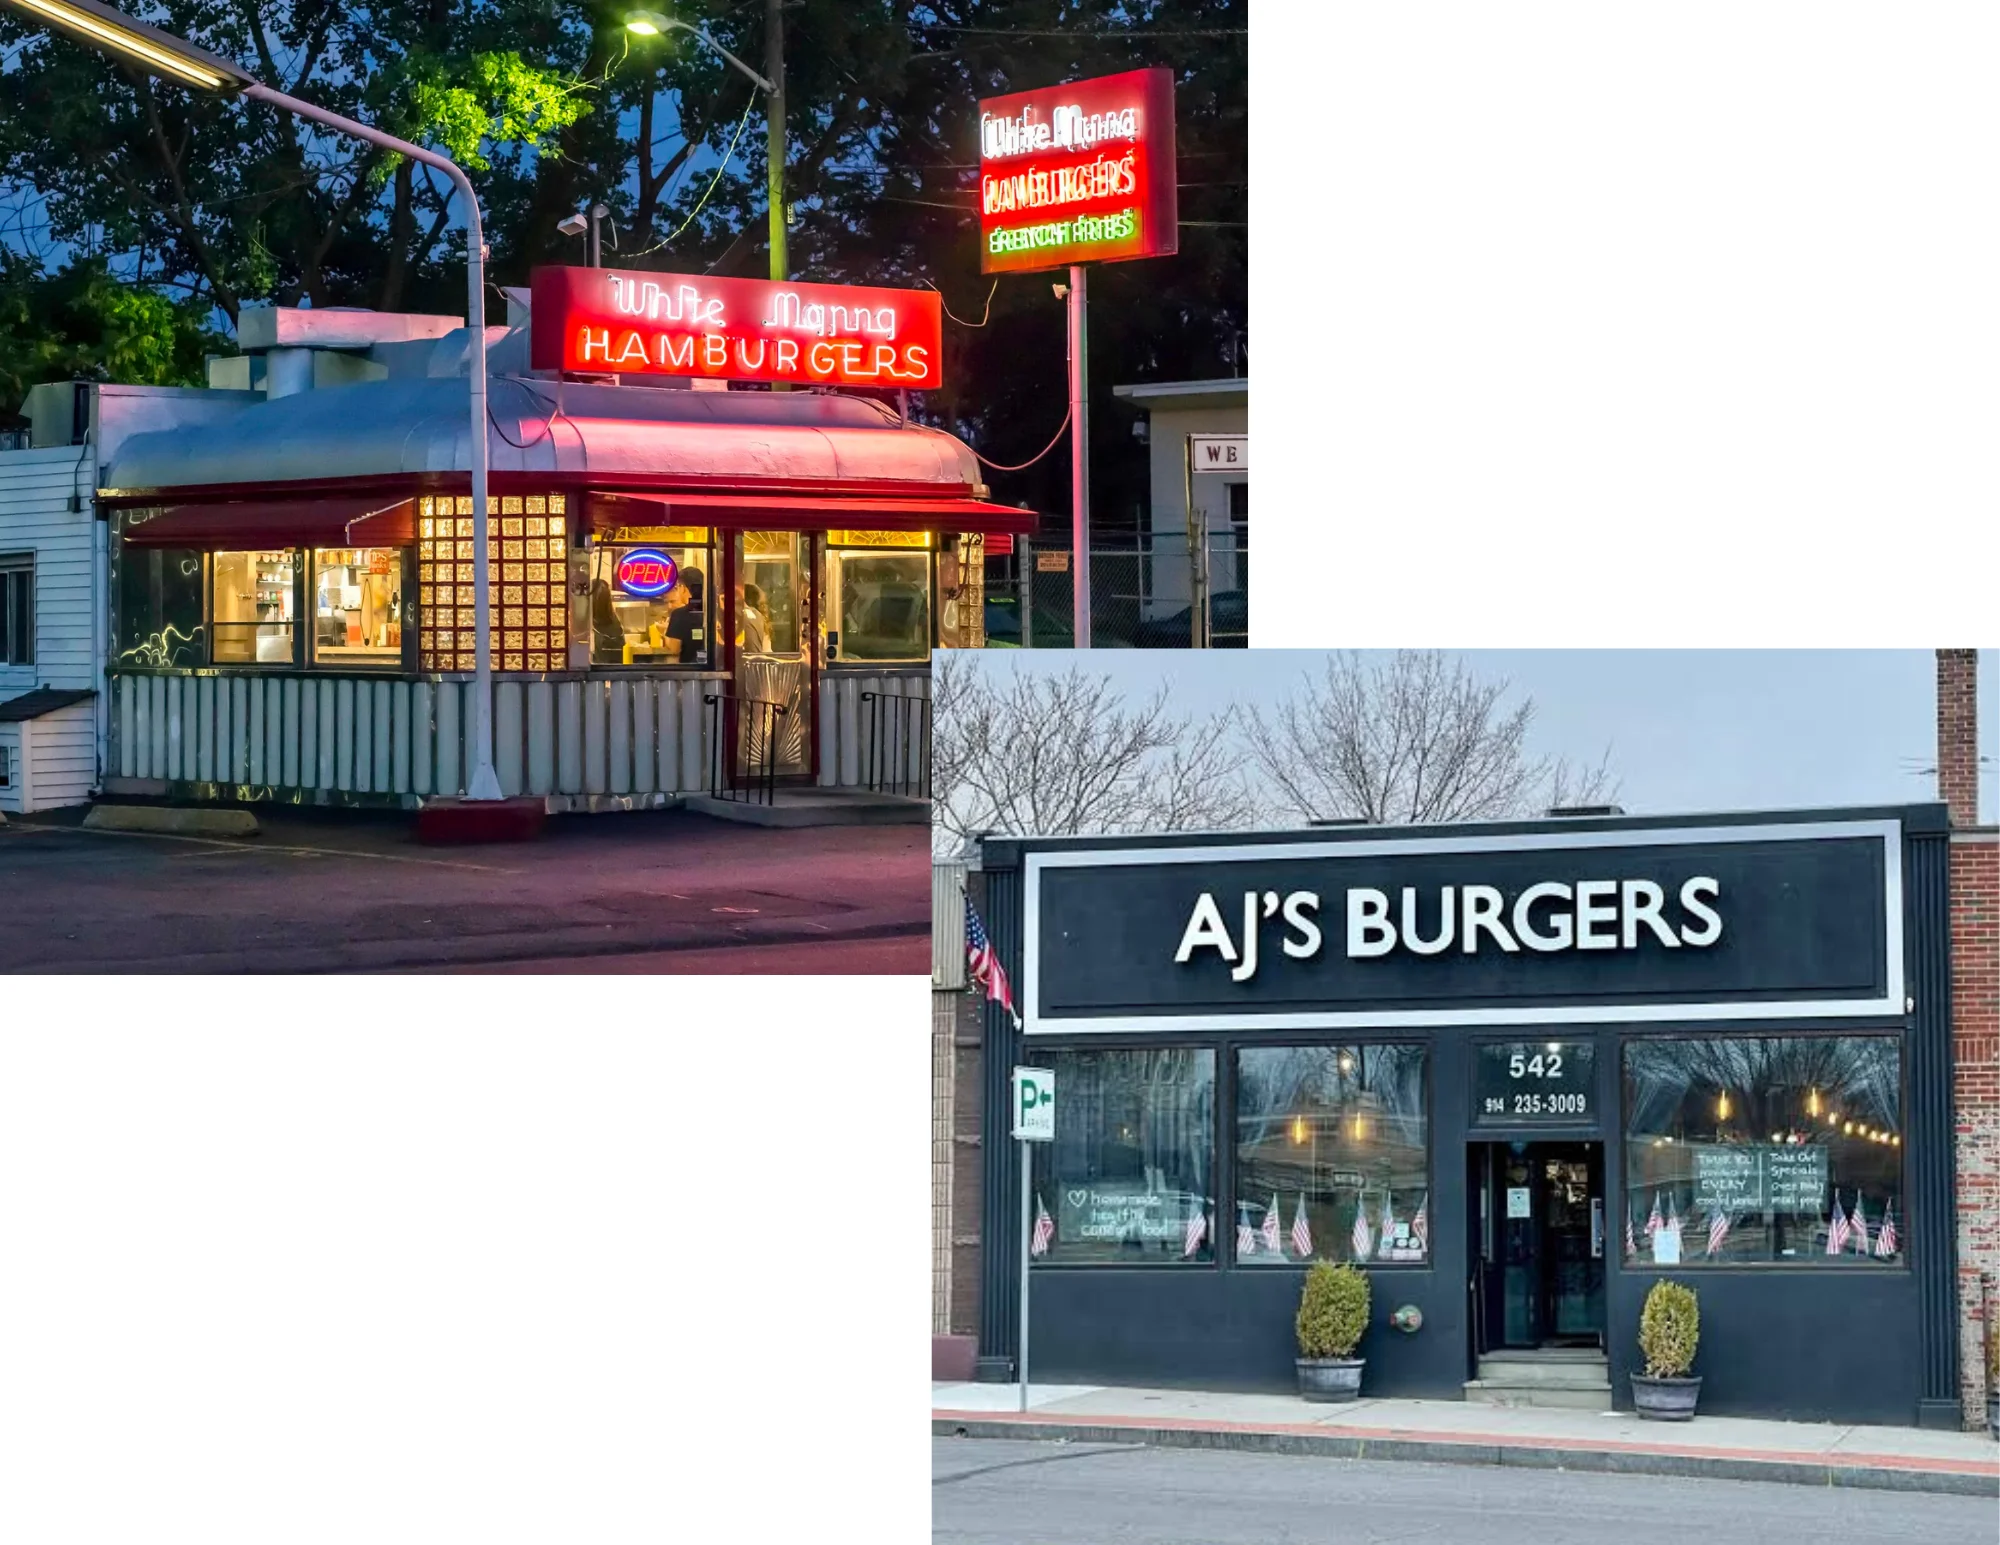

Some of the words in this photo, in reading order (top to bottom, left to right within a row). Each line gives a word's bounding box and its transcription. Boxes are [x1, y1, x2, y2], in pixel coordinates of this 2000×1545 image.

[982, 148, 1137, 215] HAMBURGERS
[989, 220, 1071, 253] FRENCH
[1072, 208, 1136, 243] FRIES
[607, 273, 726, 327] White
[761, 291, 896, 340] Manna
[582, 326, 929, 380] HAMBURGERS
[620, 562, 672, 584] OPEN
[1174, 890, 1323, 982] AJ'S
[1346, 876, 1723, 959] BURGERS
[1509, 1054, 1563, 1079] 542
[1485, 1097, 1504, 1113] 914
[1515, 1094, 1586, 1113] 235-3009
